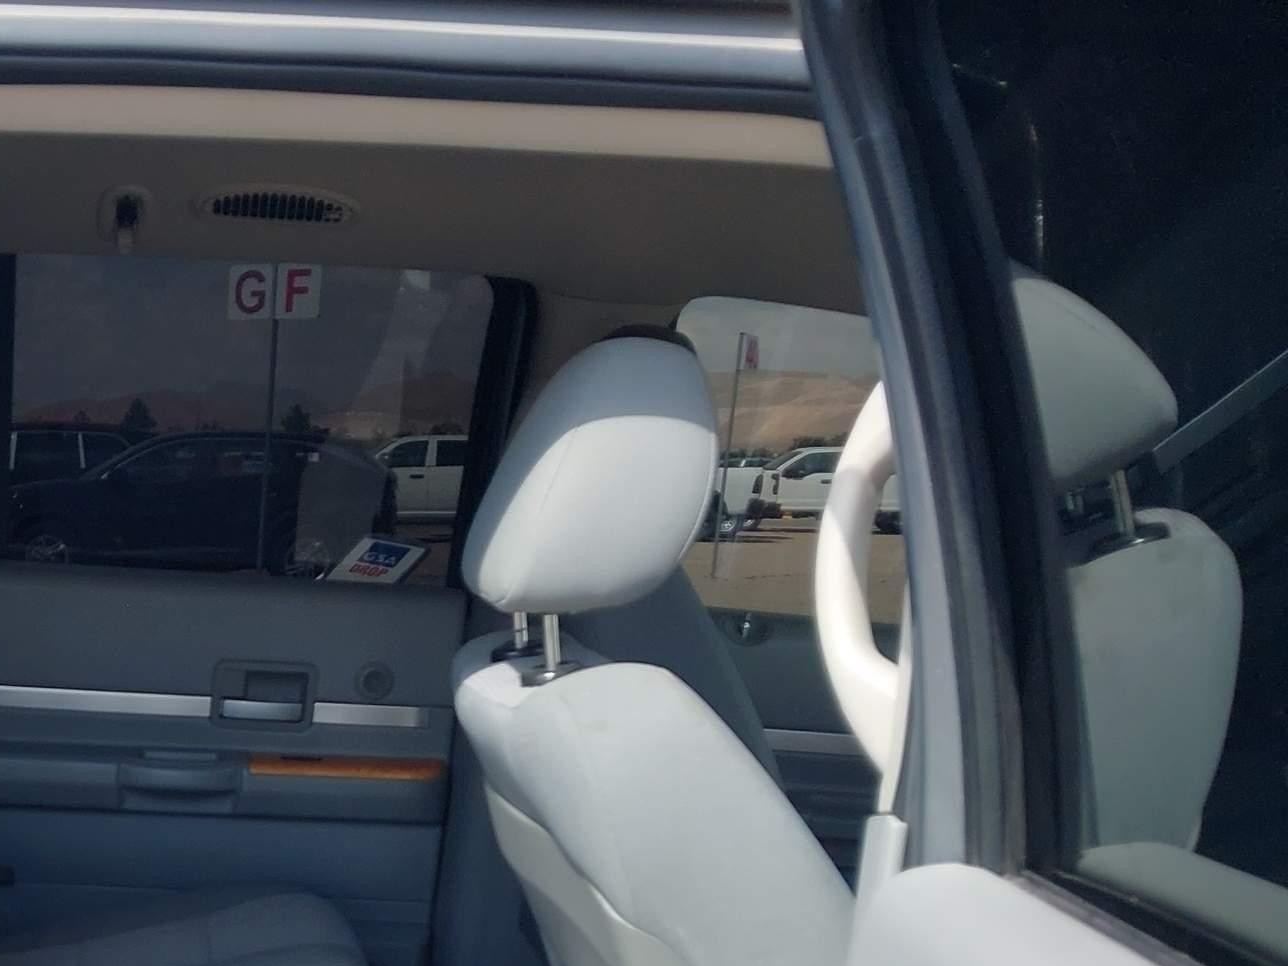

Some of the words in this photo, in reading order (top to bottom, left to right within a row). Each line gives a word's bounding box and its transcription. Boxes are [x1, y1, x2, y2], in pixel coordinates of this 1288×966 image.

[235, 269, 266, 314] G
[285, 268, 312, 313] F
[349, 562, 390, 577] DROP
